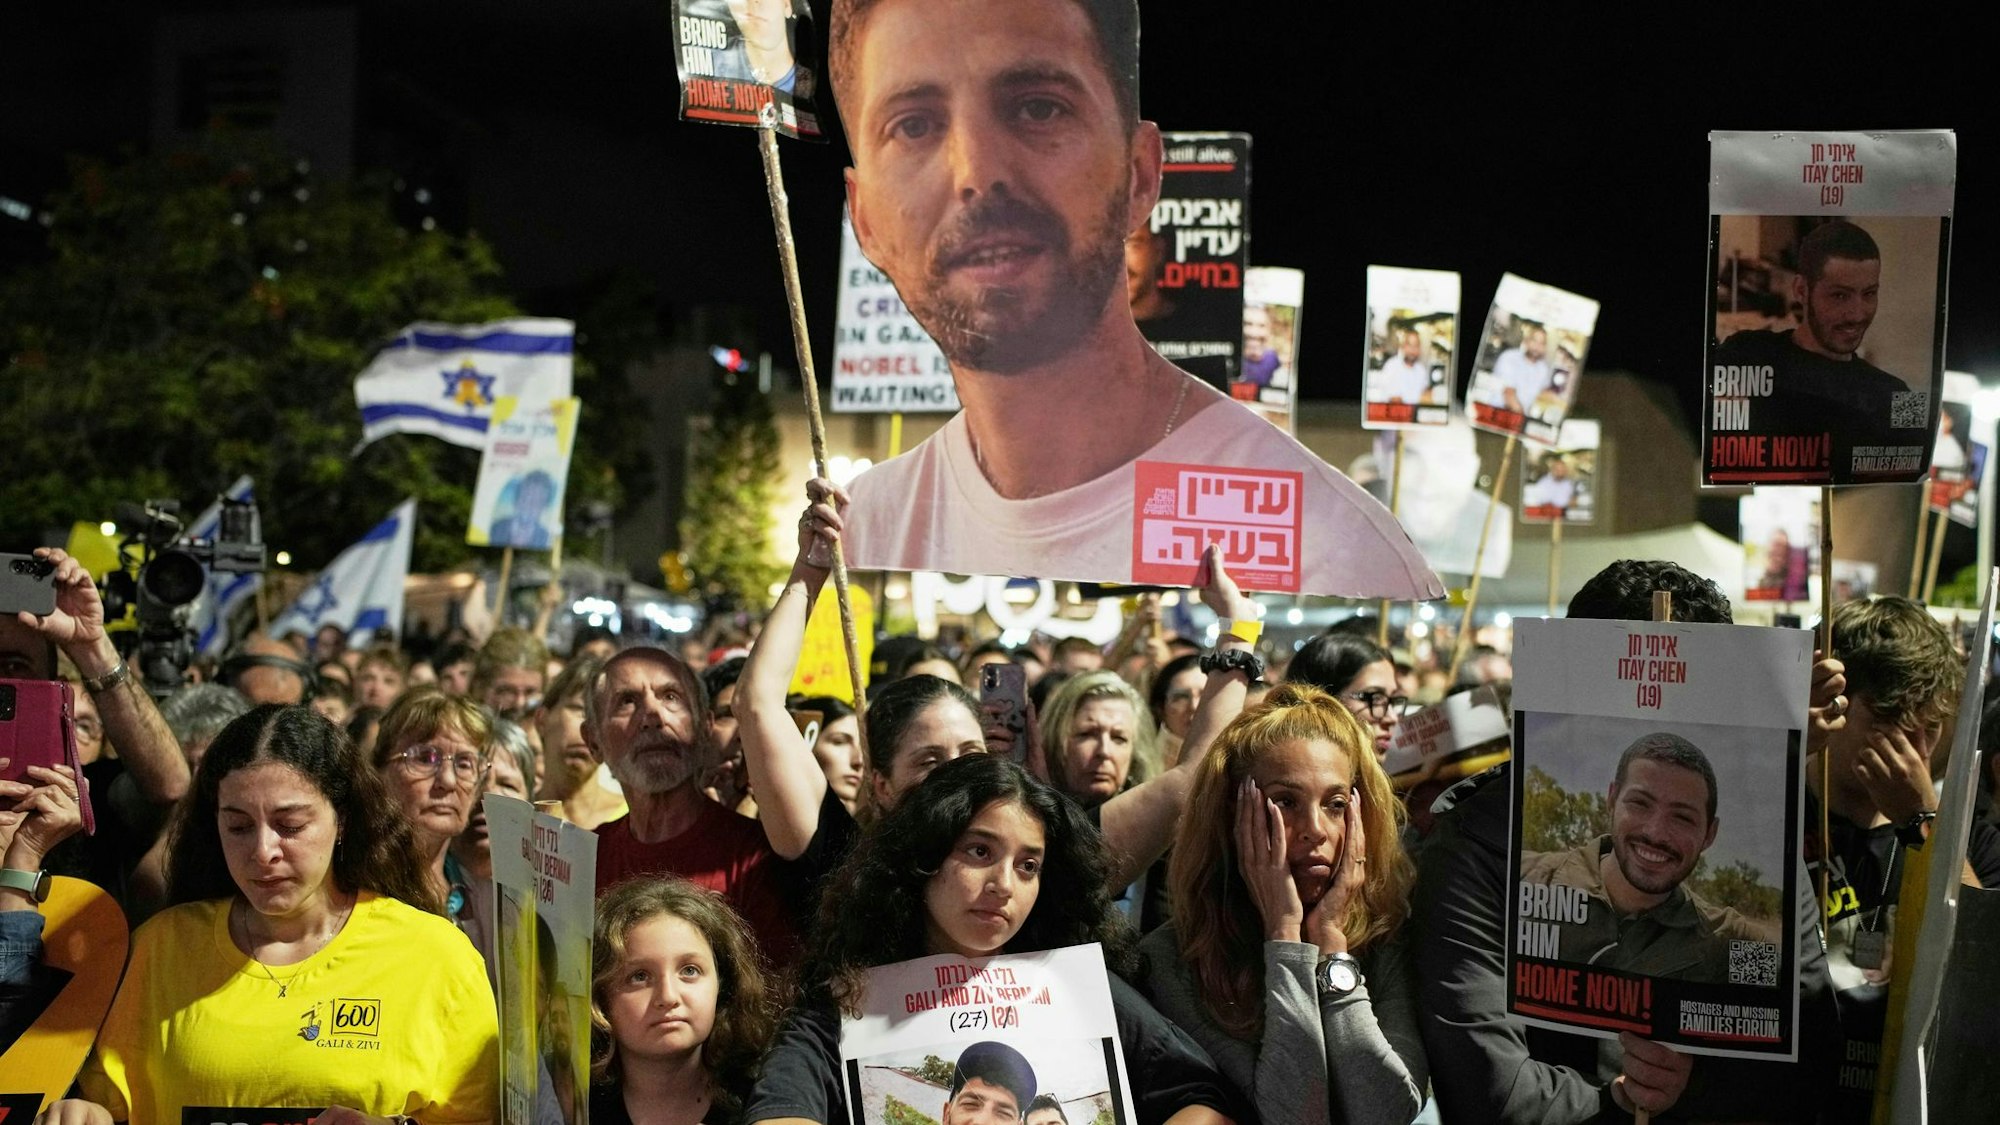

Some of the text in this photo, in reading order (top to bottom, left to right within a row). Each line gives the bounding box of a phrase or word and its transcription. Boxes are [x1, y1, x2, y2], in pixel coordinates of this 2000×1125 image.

[680, 16, 727, 50] BRING
[682, 45, 714, 76] HIM
[687, 78, 731, 109] HOME
[1168, 145, 1197, 163] still
[1198, 145, 1237, 163] alive.
[1811, 144, 1856, 163] איתי חן
[1803, 165, 1864, 183] ITAY CHEN
[1820, 185, 1844, 206] (19)
[1150, 199, 1241, 233] אבינתן
[1175, 229, 1241, 262] עדיין
[1157, 262, 1241, 288] בחיים.
[839, 356, 921, 375] NOBEL
[1714, 365, 1774, 397] BRING
[1712, 397, 1750, 431] HIM
[1712, 432, 1831, 468] HOME NOW!
[1851, 455, 1922, 472] FAMILIES FORUM
[1186, 477, 1290, 516] עדיין
[1628, 634, 1678, 658] איתי חן
[1617, 658, 1687, 684] ITAY CHEN
[1637, 683, 1662, 710] (19)
[1518, 882, 1589, 924] BRING
[1516, 921, 1560, 960] HIM
[934, 963, 968, 988] ברמן
[993, 966, 1017, 985] גלי
[905, 987, 937, 1014] GALI
[941, 986, 971, 1008] AND
[1515, 961, 1652, 1019] HOME NOW!
[335, 1003, 376, 1028] 600
[949, 1009, 988, 1033] (27)
[1680, 1000, 1780, 1021] HOSTAGES AND MISSING
[1680, 1012, 1780, 1039] FAMILIES FORUM
[317, 1039, 380, 1050] GALI & ZIVI
